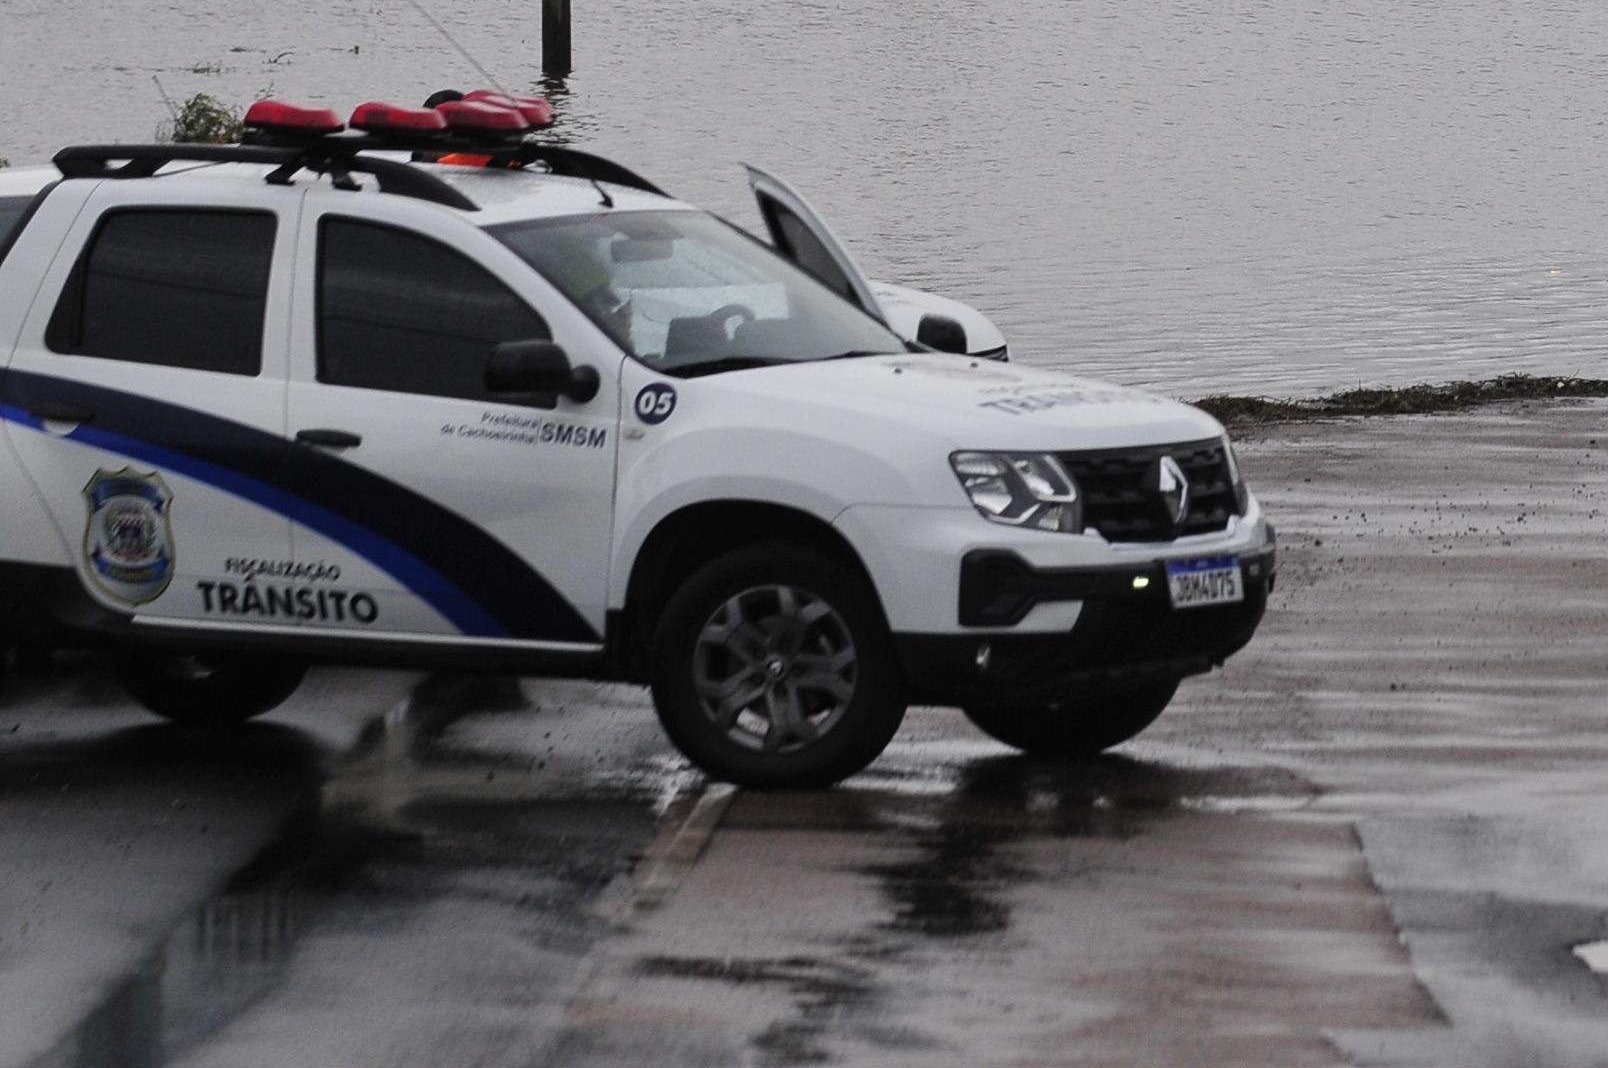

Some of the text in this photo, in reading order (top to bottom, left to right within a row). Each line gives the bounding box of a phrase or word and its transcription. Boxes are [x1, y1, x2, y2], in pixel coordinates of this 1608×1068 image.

[638, 390, 674, 416] 05
[441, 423, 456, 435] de
[481, 411, 539, 430] Prefeitura
[541, 422, 608, 450] SMSM
[225, 556, 341, 582] FISCALIZAÇÃO
[197, 575, 379, 624] TRÂNSITO
